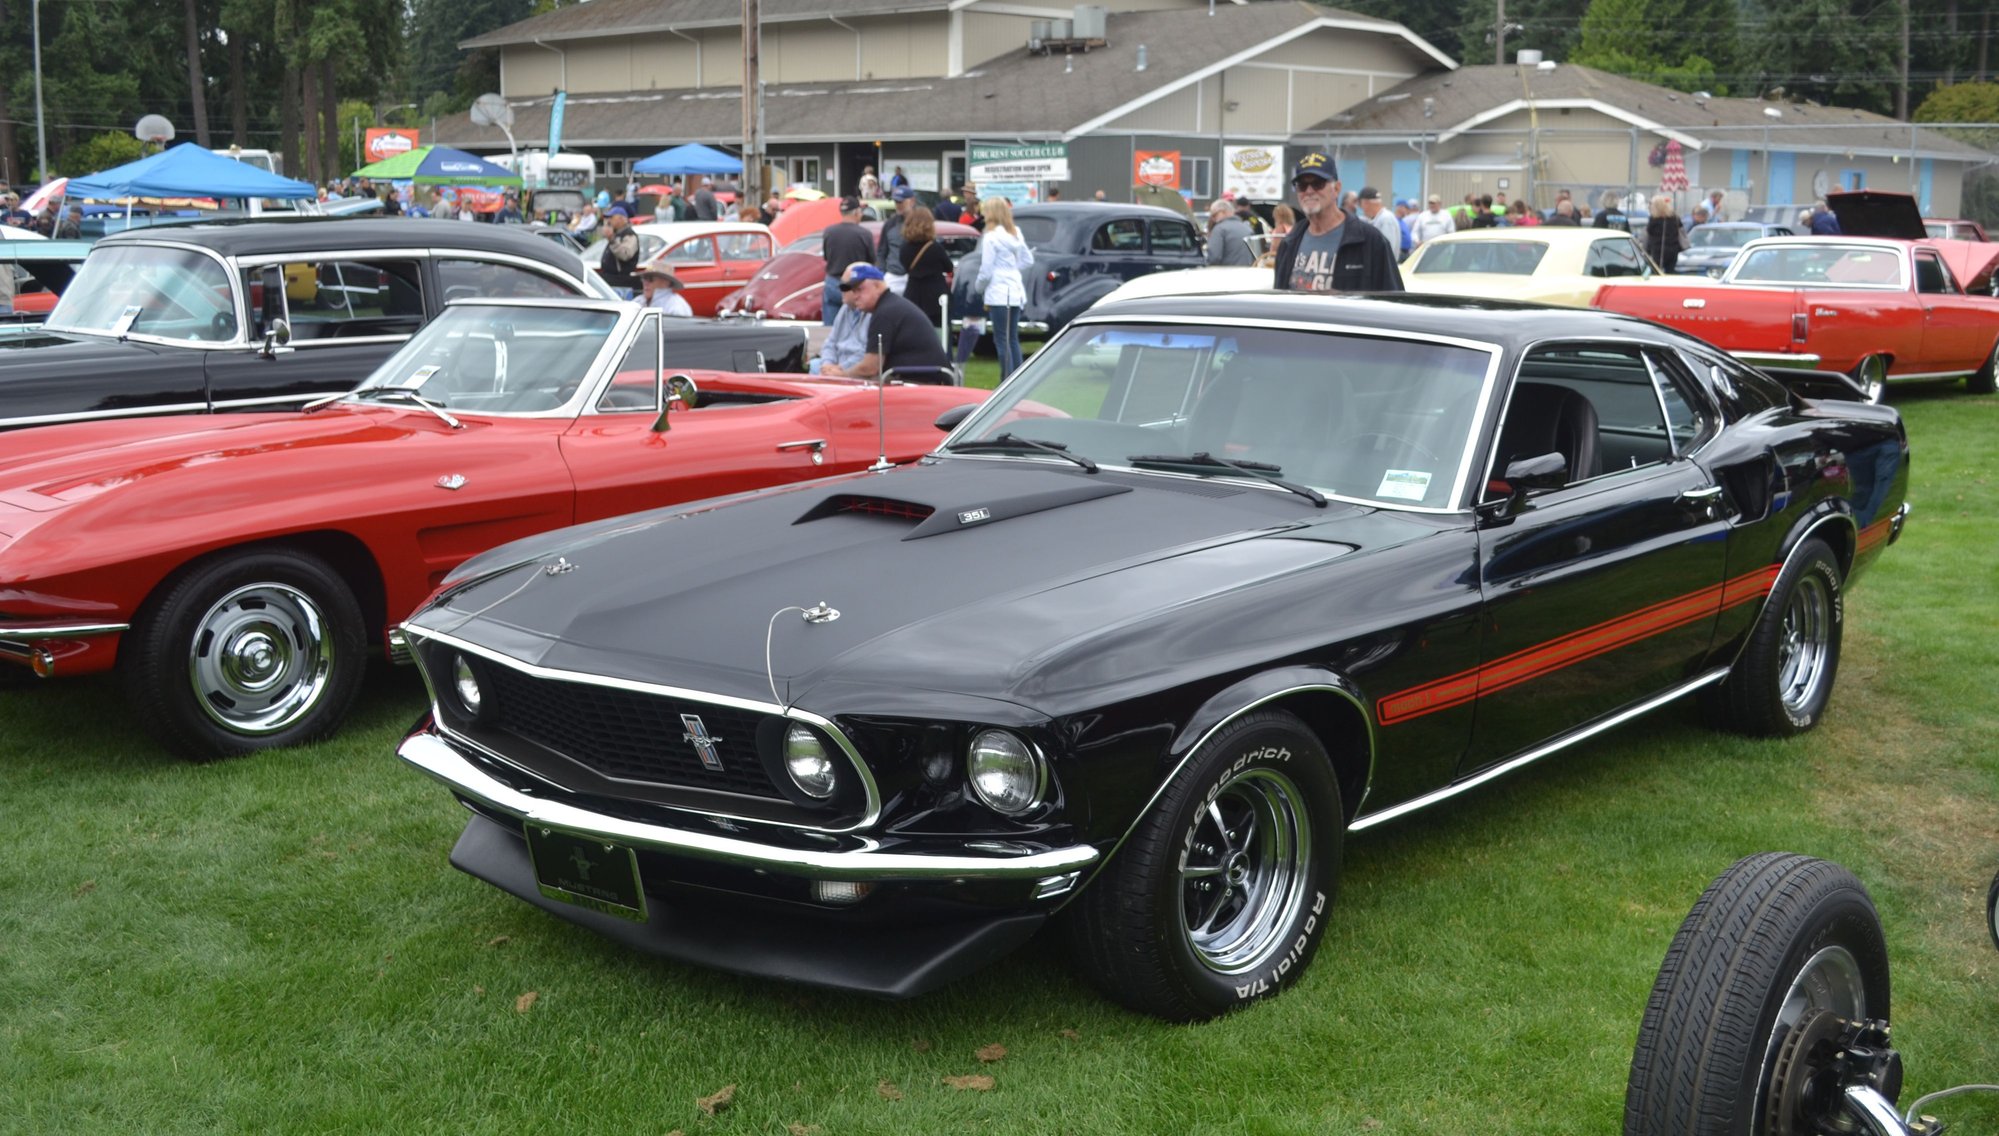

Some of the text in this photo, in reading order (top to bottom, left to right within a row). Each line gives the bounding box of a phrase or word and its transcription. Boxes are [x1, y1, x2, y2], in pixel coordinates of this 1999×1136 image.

[1010, 148, 1040, 157] SOCCER
[1040, 146, 1065, 157] CLUB
[984, 165, 1022, 173] REGISTRATION
[963, 510, 985, 521] 351
[1833, 593, 1842, 623] T/A
[1177, 746, 1291, 873] BFGoodrich
[558, 877, 619, 901] MUSTANG
[1235, 891, 1326, 1000] Radial T/A
